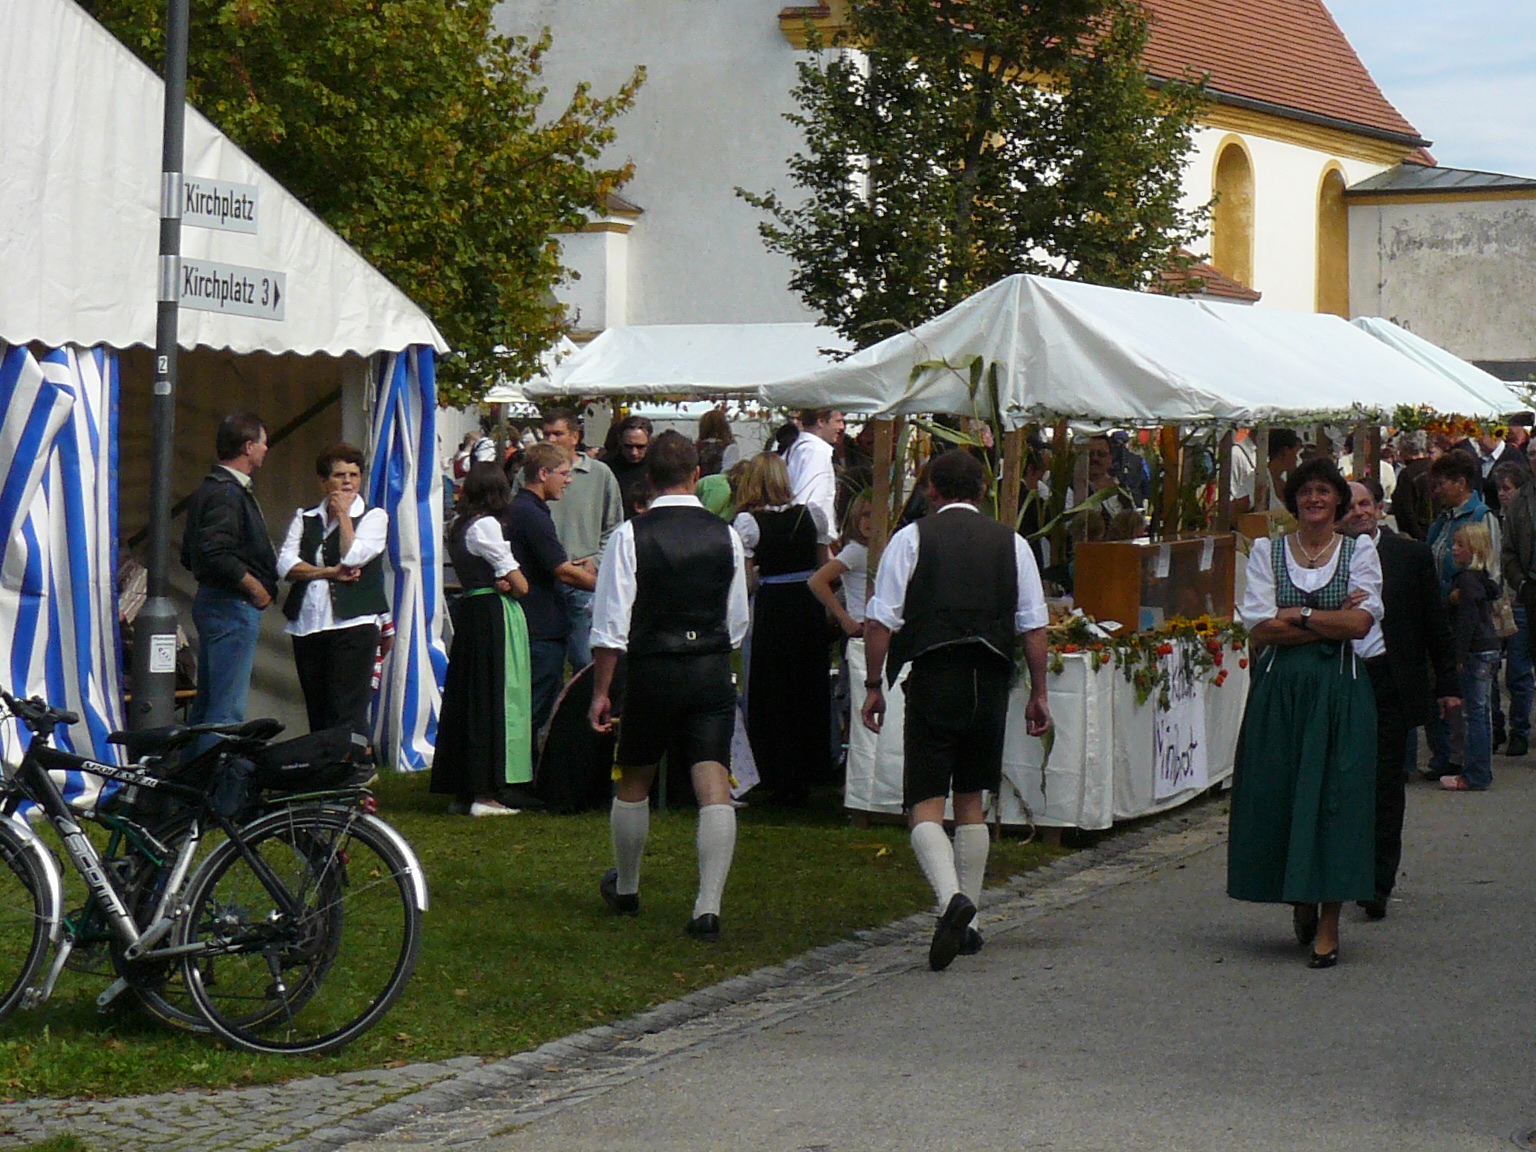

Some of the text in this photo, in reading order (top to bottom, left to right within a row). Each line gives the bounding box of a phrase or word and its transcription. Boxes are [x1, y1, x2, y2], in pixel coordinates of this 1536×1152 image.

[184, 183, 254, 224] Kirchplatz
[182, 265, 270, 307] Kirchplatz 3
[64, 833, 127, 916] SCOTT
